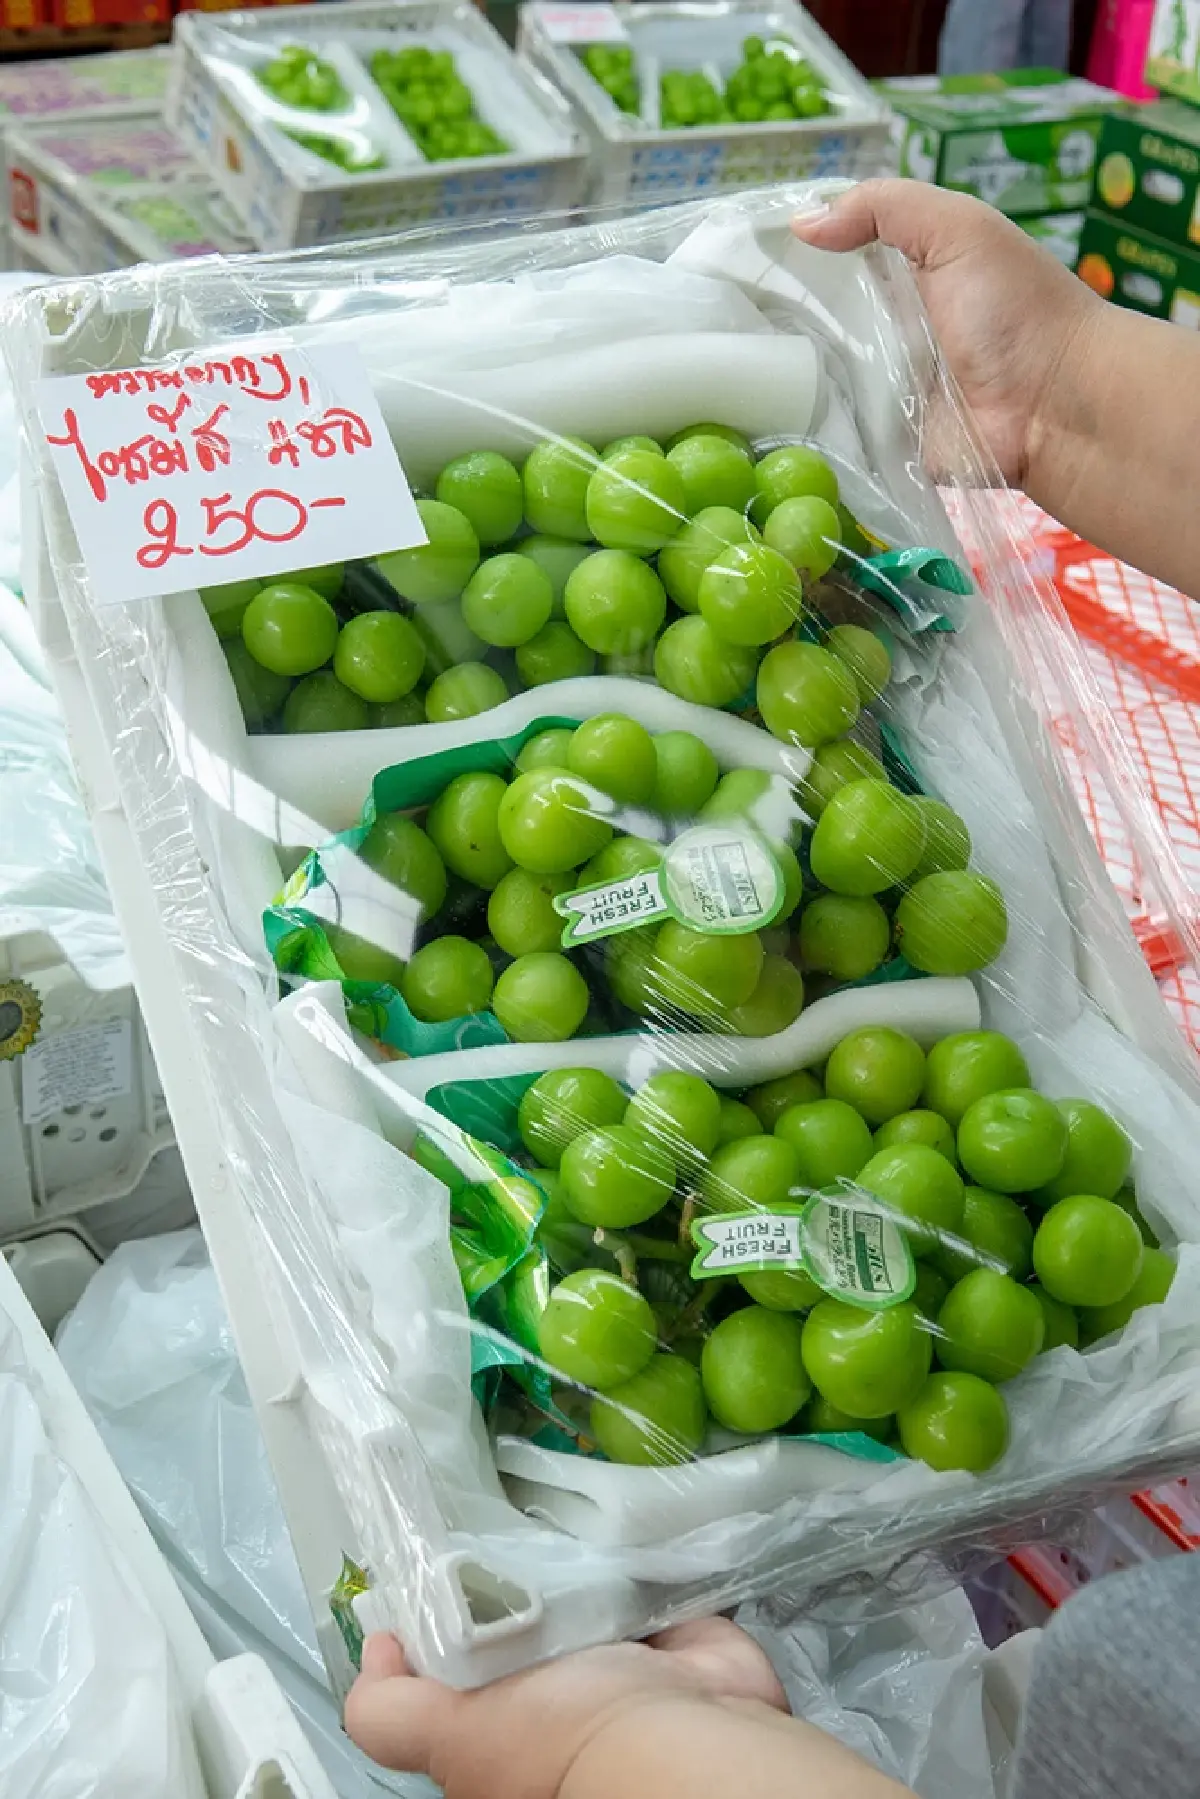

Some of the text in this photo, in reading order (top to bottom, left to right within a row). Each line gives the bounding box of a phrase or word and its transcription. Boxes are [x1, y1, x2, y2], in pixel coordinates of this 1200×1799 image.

[591, 881, 649, 910] FRUIT
[590, 894, 658, 925] FRESH
[725, 1222, 786, 1240] FRUIT
[722, 1239, 792, 1259] FRESH
